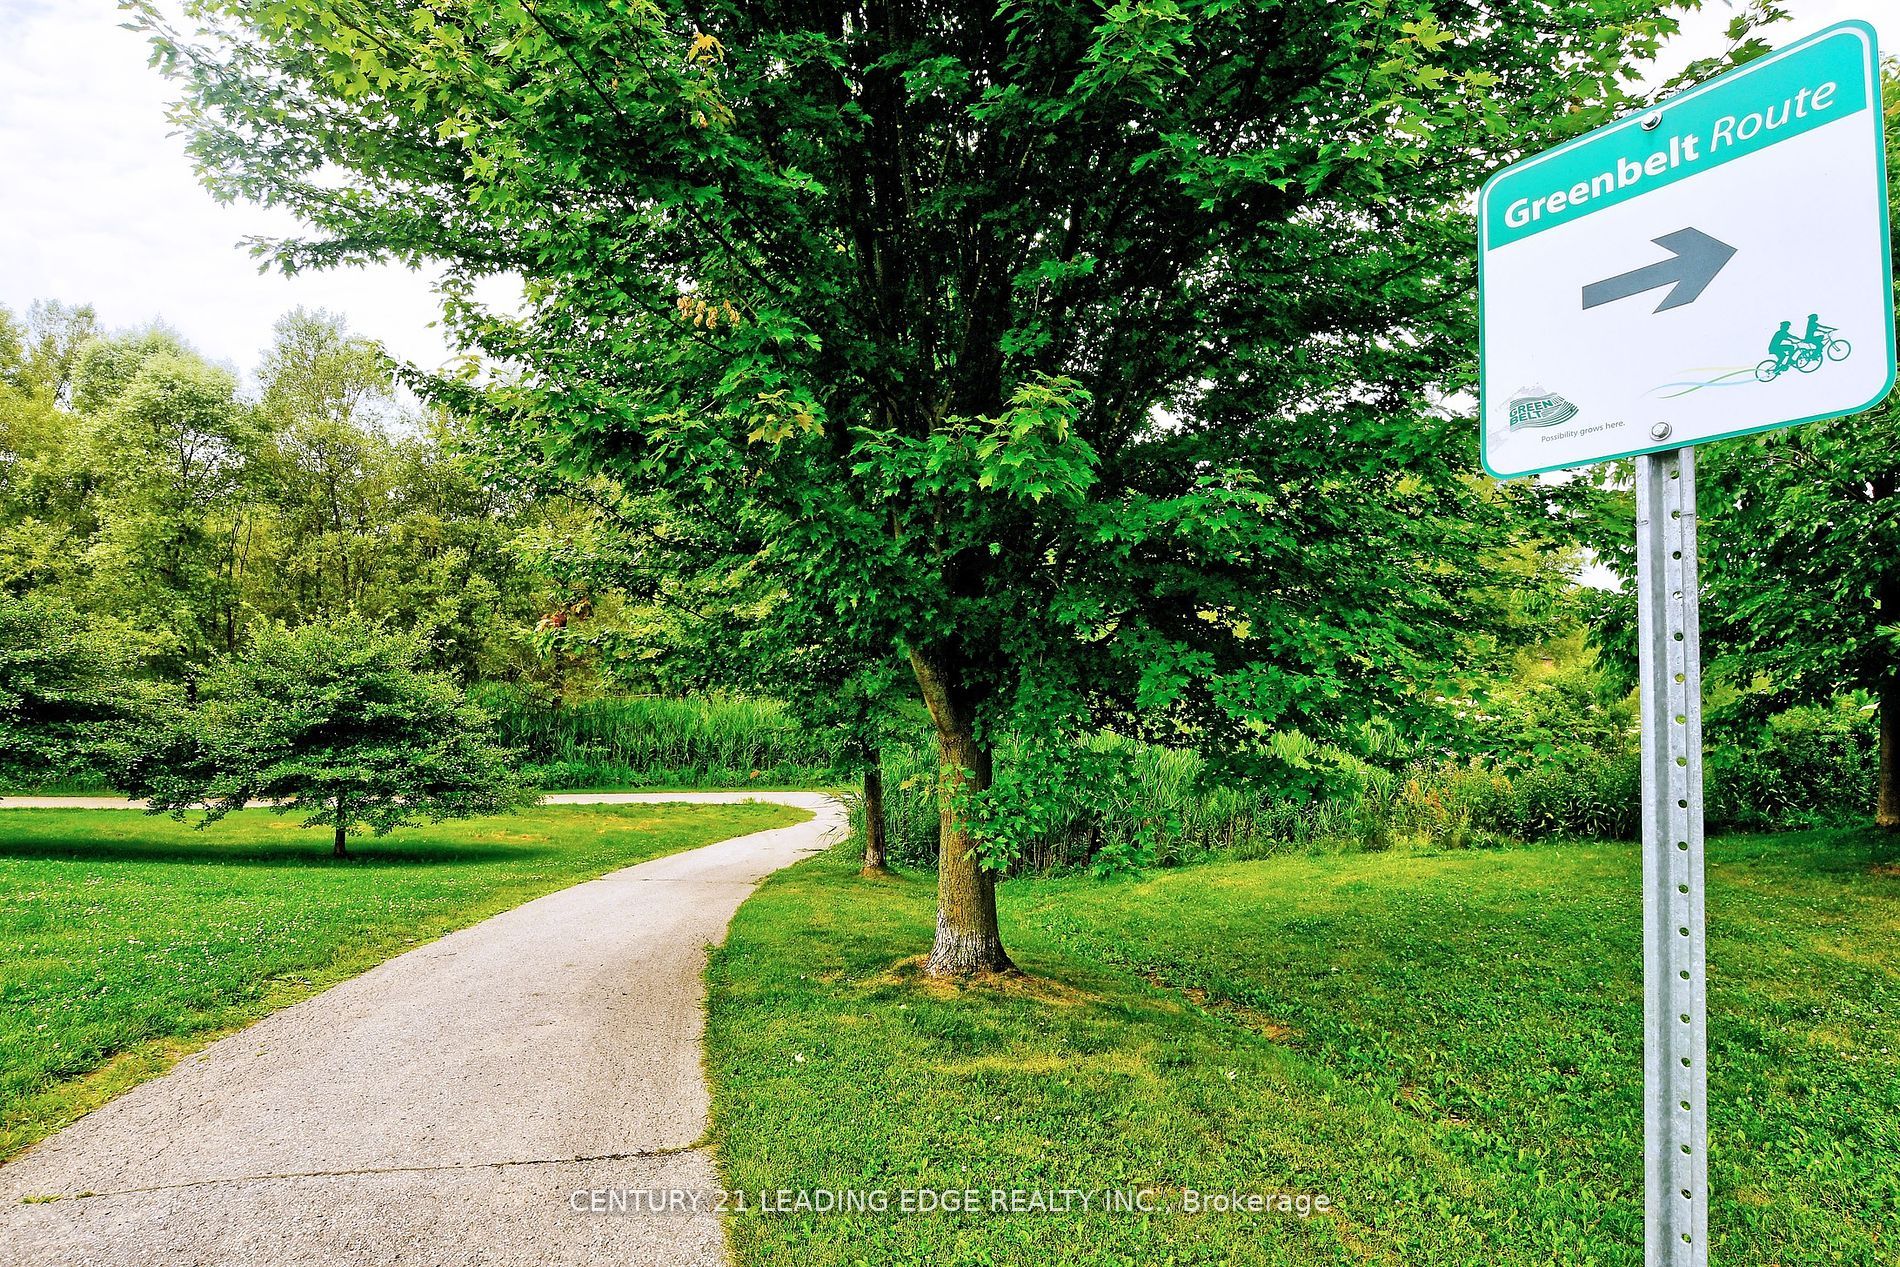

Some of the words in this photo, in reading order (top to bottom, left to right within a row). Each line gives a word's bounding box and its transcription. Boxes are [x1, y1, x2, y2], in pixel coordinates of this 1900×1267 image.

[1504, 135, 1700, 229] Greenbelt
[1710, 80, 1837, 153] Route
[1509, 399, 1554, 418] GREEN
[1509, 410, 1544, 426] BELT
[1541, 430, 1579, 443] Possibility
[1579, 425, 1604, 437] grows
[1605, 419, 1626, 431] here.
